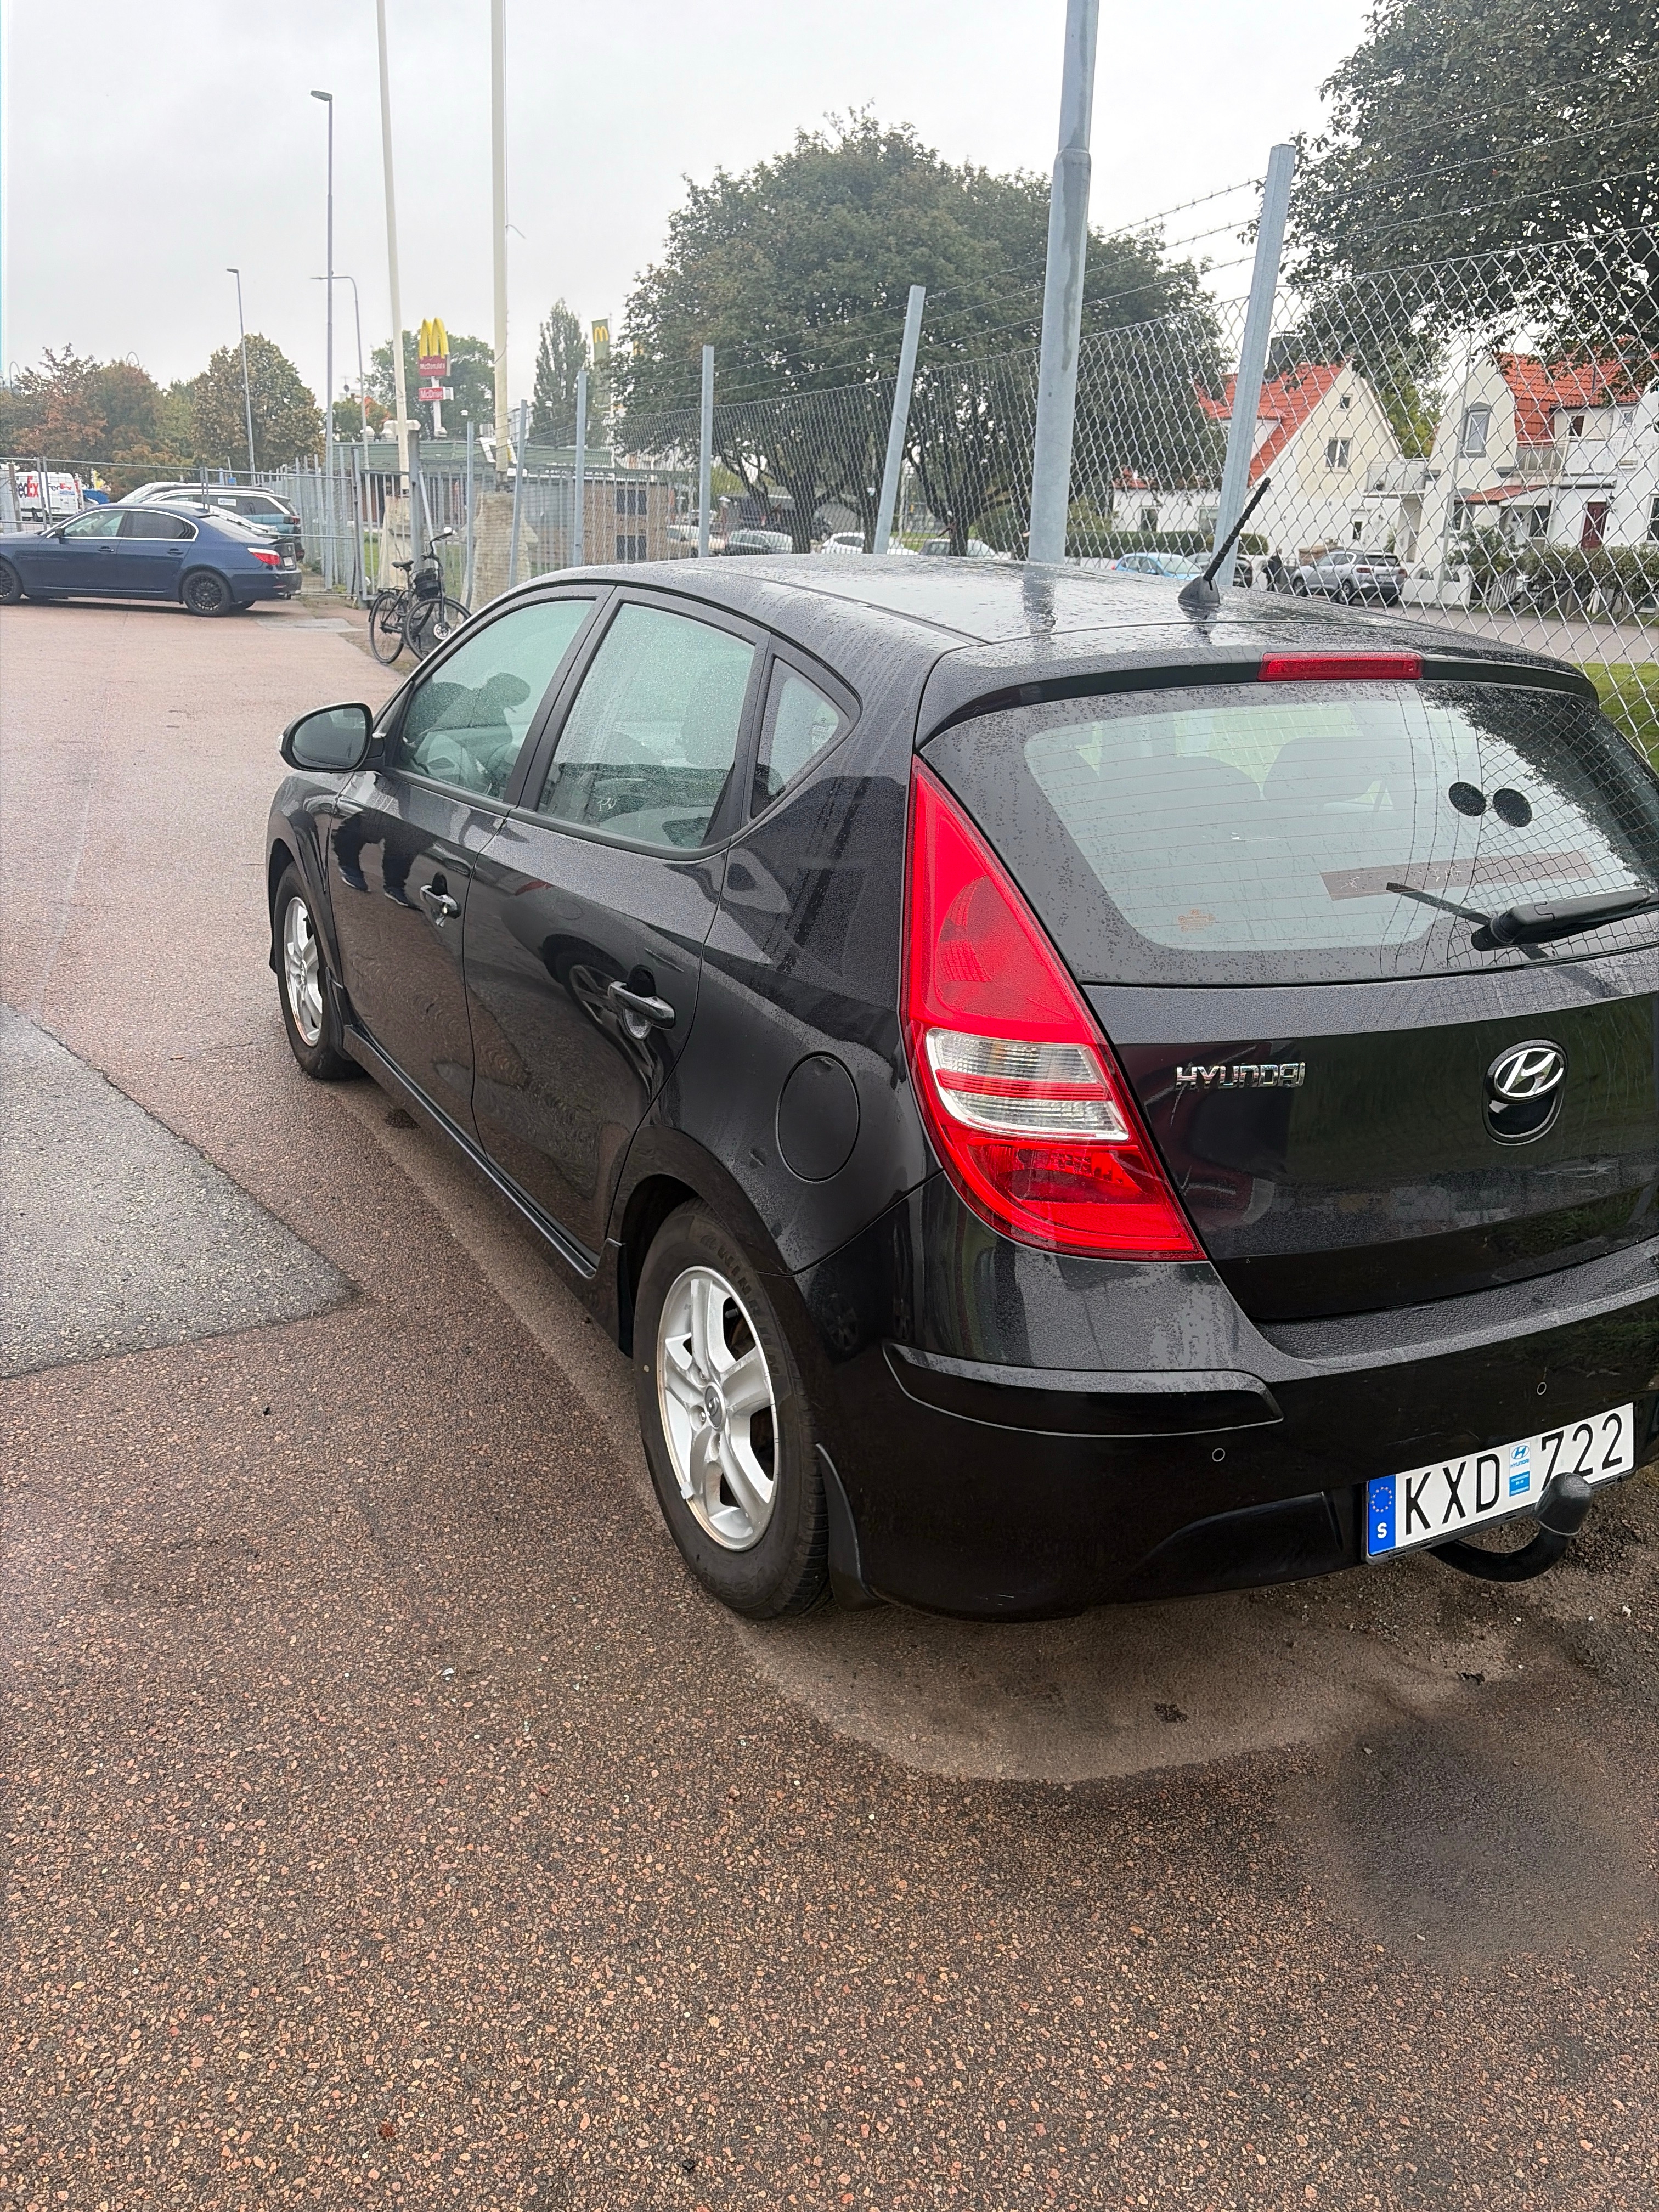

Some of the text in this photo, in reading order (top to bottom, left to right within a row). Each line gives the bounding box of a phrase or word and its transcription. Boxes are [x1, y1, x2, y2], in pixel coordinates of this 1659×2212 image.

[420, 389, 443, 397] McDrive
[17, 476, 39, 498] edEx
[1175, 1062, 1306, 1090] HYUNDAI
[1510, 1459, 1530, 1468] HYUNDAI
[1406, 1413, 1622, 1535] KXD 722
[1377, 1522, 1387, 1539] S
